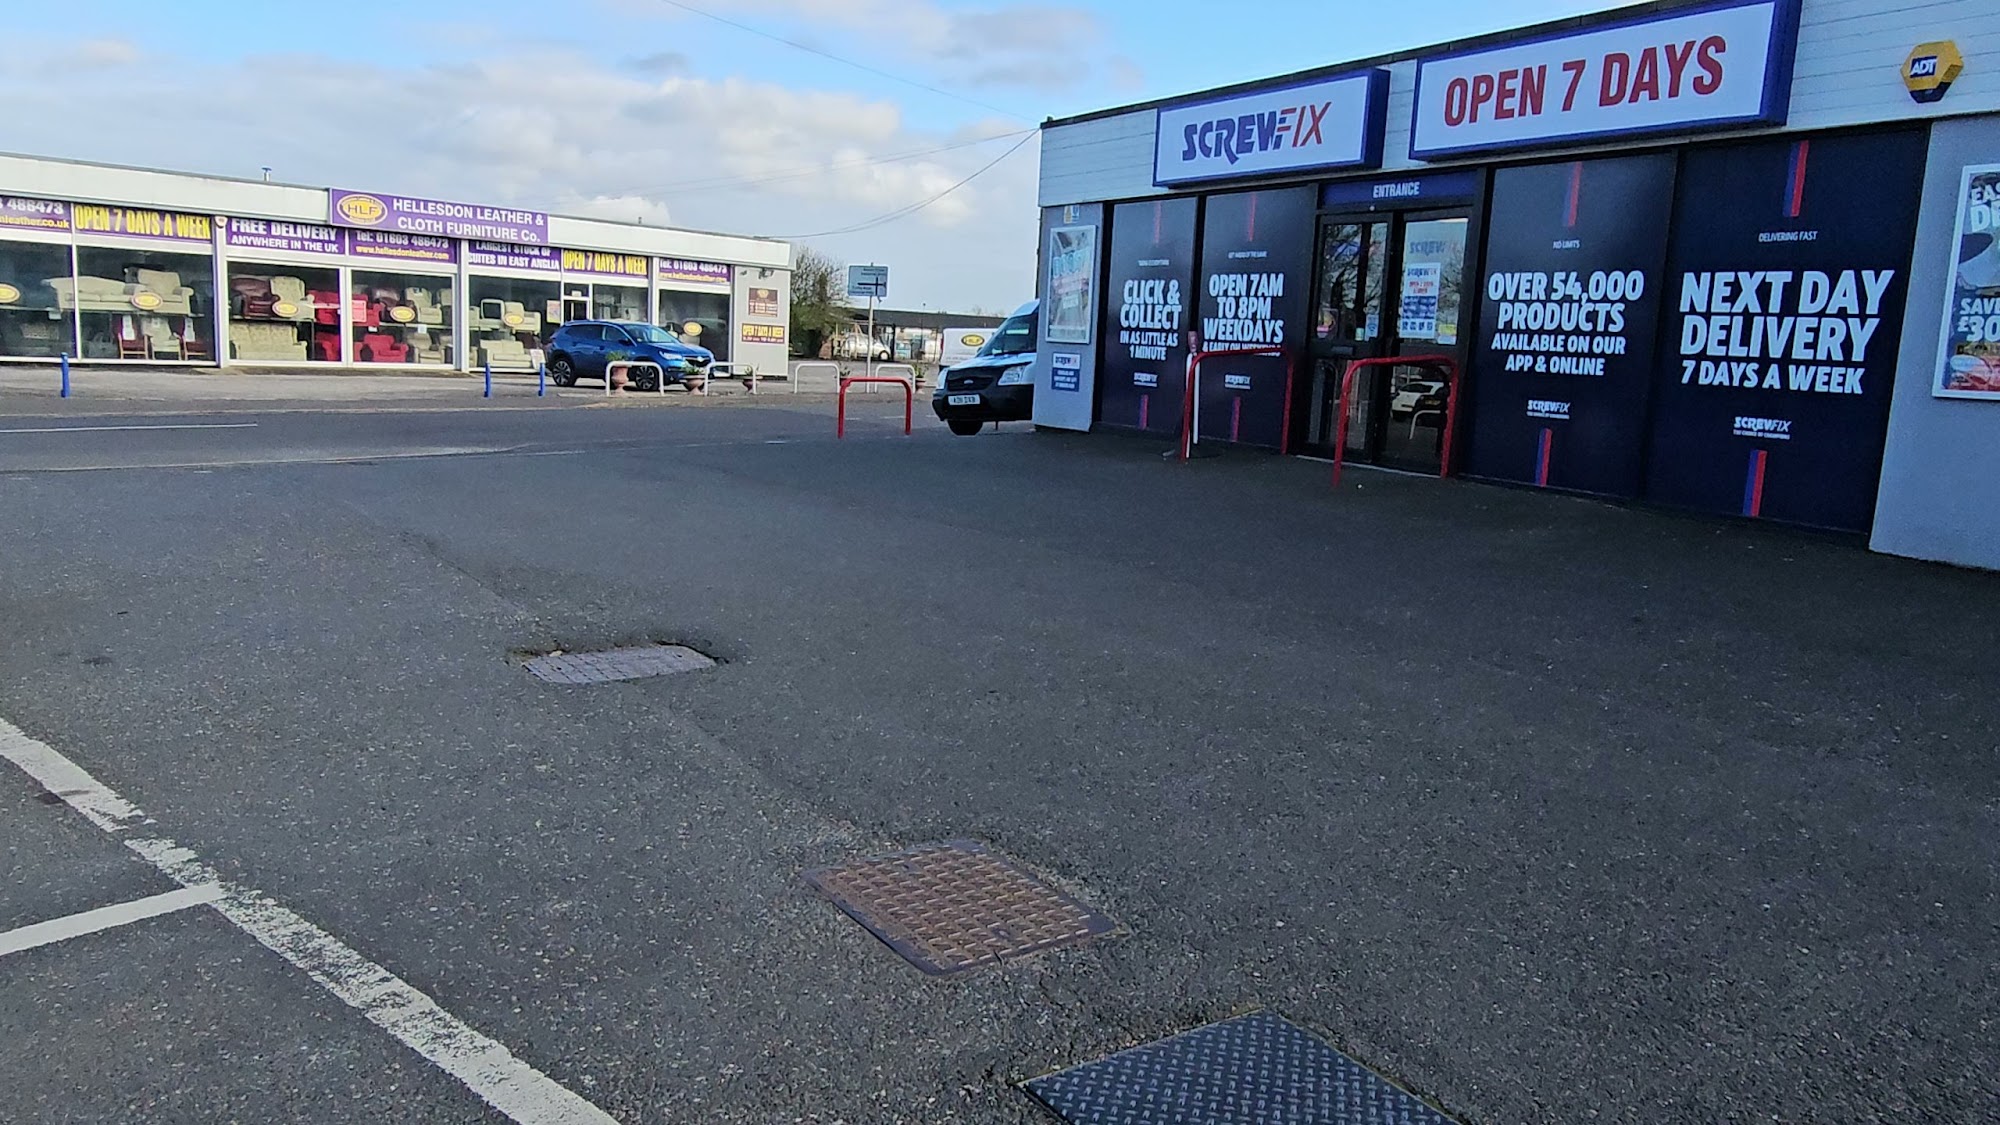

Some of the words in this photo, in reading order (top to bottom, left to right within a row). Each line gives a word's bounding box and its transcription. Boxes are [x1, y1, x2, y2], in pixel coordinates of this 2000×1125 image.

[1910, 59, 1938, 76] ADT
[1444, 64, 1547, 126] OPEN
[1561, 59, 1586, 112] 7
[1598, 35, 1726, 107] DAYS
[1182, 101, 1332, 165] SCREWFIX
[1373, 181, 1421, 199] ENTRANCE
[6, 198, 64, 215] 486473
[347, 204, 378, 215] HLF
[393, 198, 473, 219] HELLESDON
[477, 208, 533, 225] LEATHER
[535, 214, 544, 227] &
[75, 204, 110, 231] OPEN
[113, 208, 122, 232] 7
[126, 210, 160, 235] DAYS
[163, 212, 174, 236] A
[176, 213, 211, 239] WEEK
[231, 218, 267, 234] FREE
[270, 221, 337, 241] DELIVERY
[397, 216, 445, 233] CLOTH
[446, 221, 519, 241] FURNITURE
[521, 229, 541, 243] Co.
[231, 235, 289, 249] ANYWHERE
[290, 240, 302, 249] IN
[301, 241, 323, 251] THE
[324, 244, 339, 253] UK
[375, 232, 408, 245] 01603
[1552, 240, 1562, 249] NO
[1758, 231, 1798, 242] DELIVERING
[1799, 230, 1818, 241] FAST
[468, 252, 496, 265] SUITES
[497, 255, 507, 266] IN
[509, 256, 529, 268] EAST
[530, 258, 560, 270] ANGLIA
[563, 250, 585, 270] OPEN
[586, 252, 593, 270] 7
[594, 253, 616, 273] DAYS
[617, 255, 624, 274] A
[625, 256, 648, 276] WEEK
[1123, 279, 1165, 304] CLICK
[1166, 279, 1181, 305] &
[1208, 273, 1248, 297] OPEN
[1249, 272, 1285, 297] 7AM
[1488, 272, 1548, 301] OVER
[1551, 270, 1645, 306] 54,000
[1679, 271, 1793, 314] NEXT
[1798, 269, 1896, 315] DAY
[1120, 303, 1183, 330] COLLECT
[1217, 296, 1236, 319] TO
[1237, 296, 1271, 320] 8PM
[1497, 301, 1626, 333] PRODUCTS
[1120, 330, 1130, 344] IN
[1130, 330, 1141, 344] AS
[1141, 331, 1167, 346] LITTLE
[1166, 332, 1179, 347] AS
[1203, 317, 1285, 344] WEEKDAYS
[1679, 315, 1881, 362] DELIVERY
[1129, 344, 1135, 358] 1
[1135, 345, 1167, 361] MINUTE
[1202, 341, 1209, 352] &
[1491, 332, 1566, 353] AVAILABLE
[1567, 335, 1590, 354] ON
[1592, 336, 1626, 355] OUR
[1505, 354, 1534, 372] APP
[1534, 355, 1547, 373] &
[1550, 356, 1606, 376] ONLINE
[1681, 360, 1697, 385] 7
[1698, 361, 1760, 388] DAYS
[1762, 363, 1781, 390] A
[1788, 364, 1865, 395] WEEK
[1733, 416, 1792, 433] SCREWFIX
